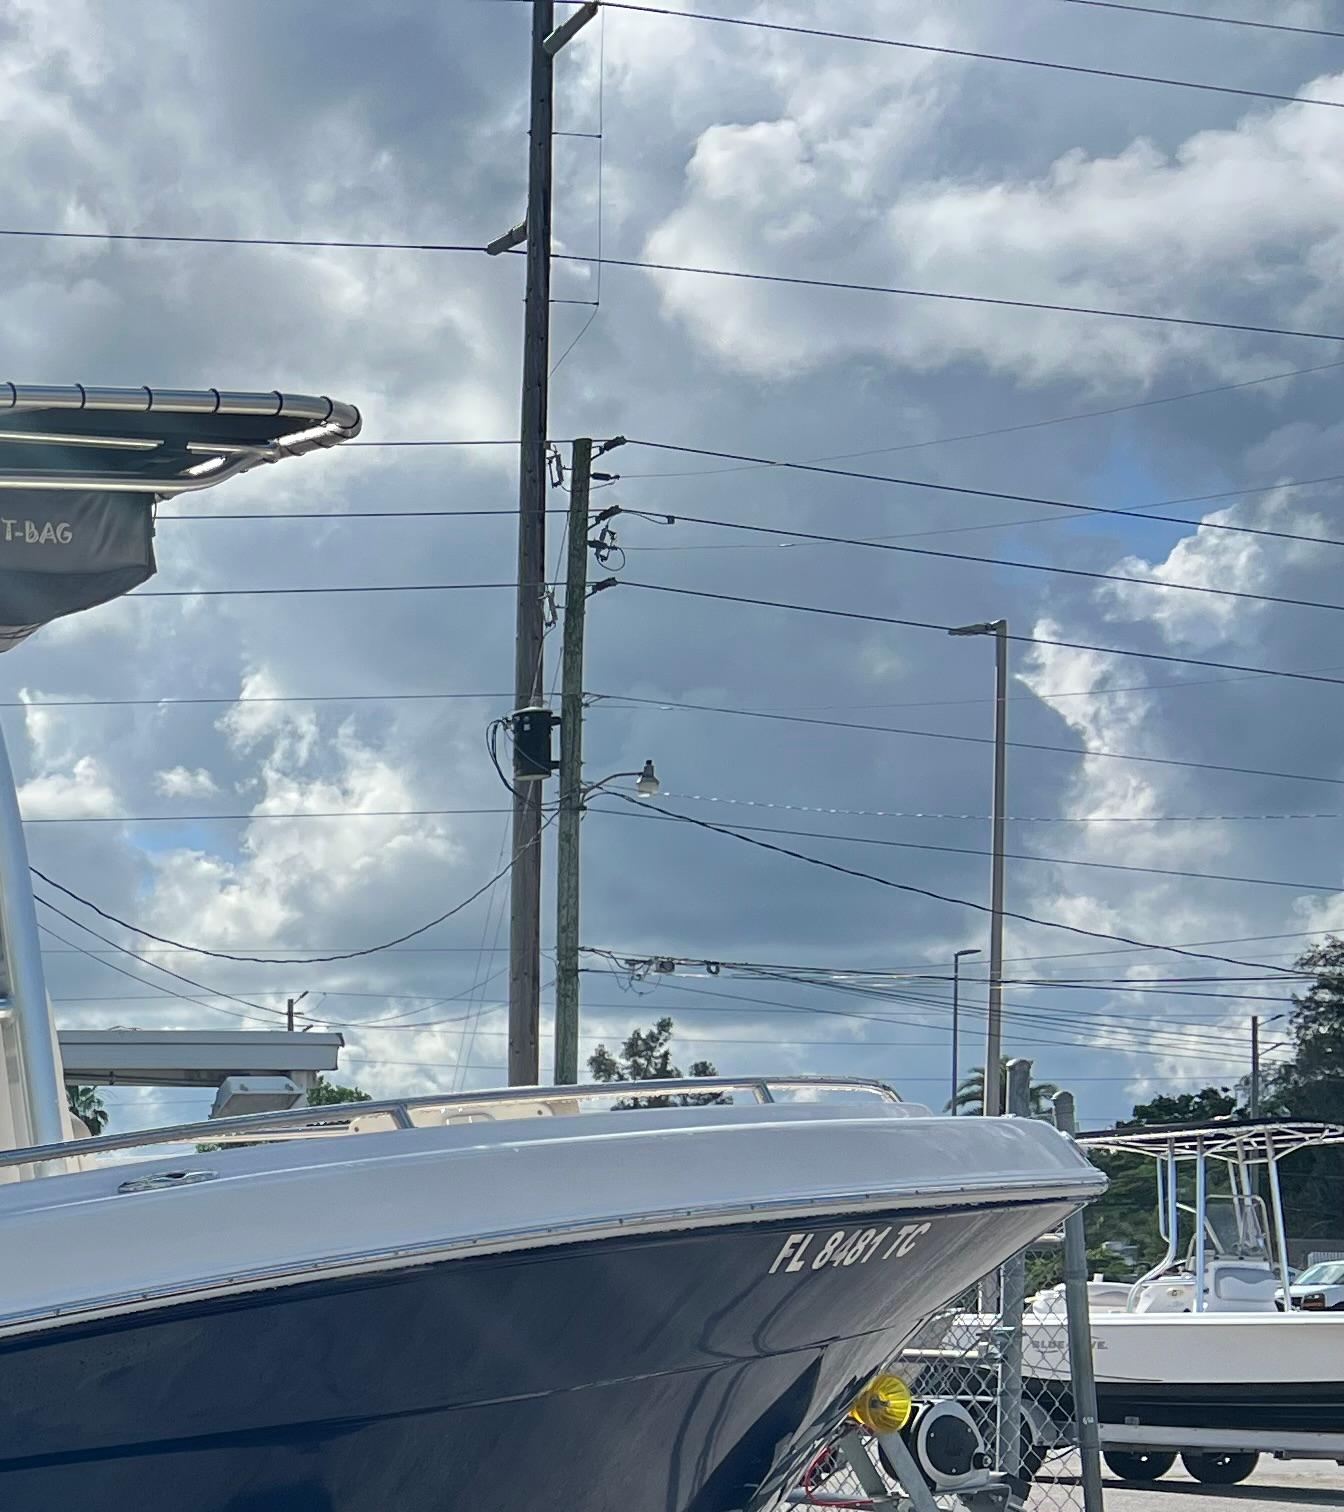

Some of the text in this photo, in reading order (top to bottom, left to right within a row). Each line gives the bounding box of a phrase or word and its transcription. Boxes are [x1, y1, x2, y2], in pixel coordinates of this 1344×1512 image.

[0, 517, 73, 544] T-BAG
[768, 1222, 932, 1275] FL 8481 TC
